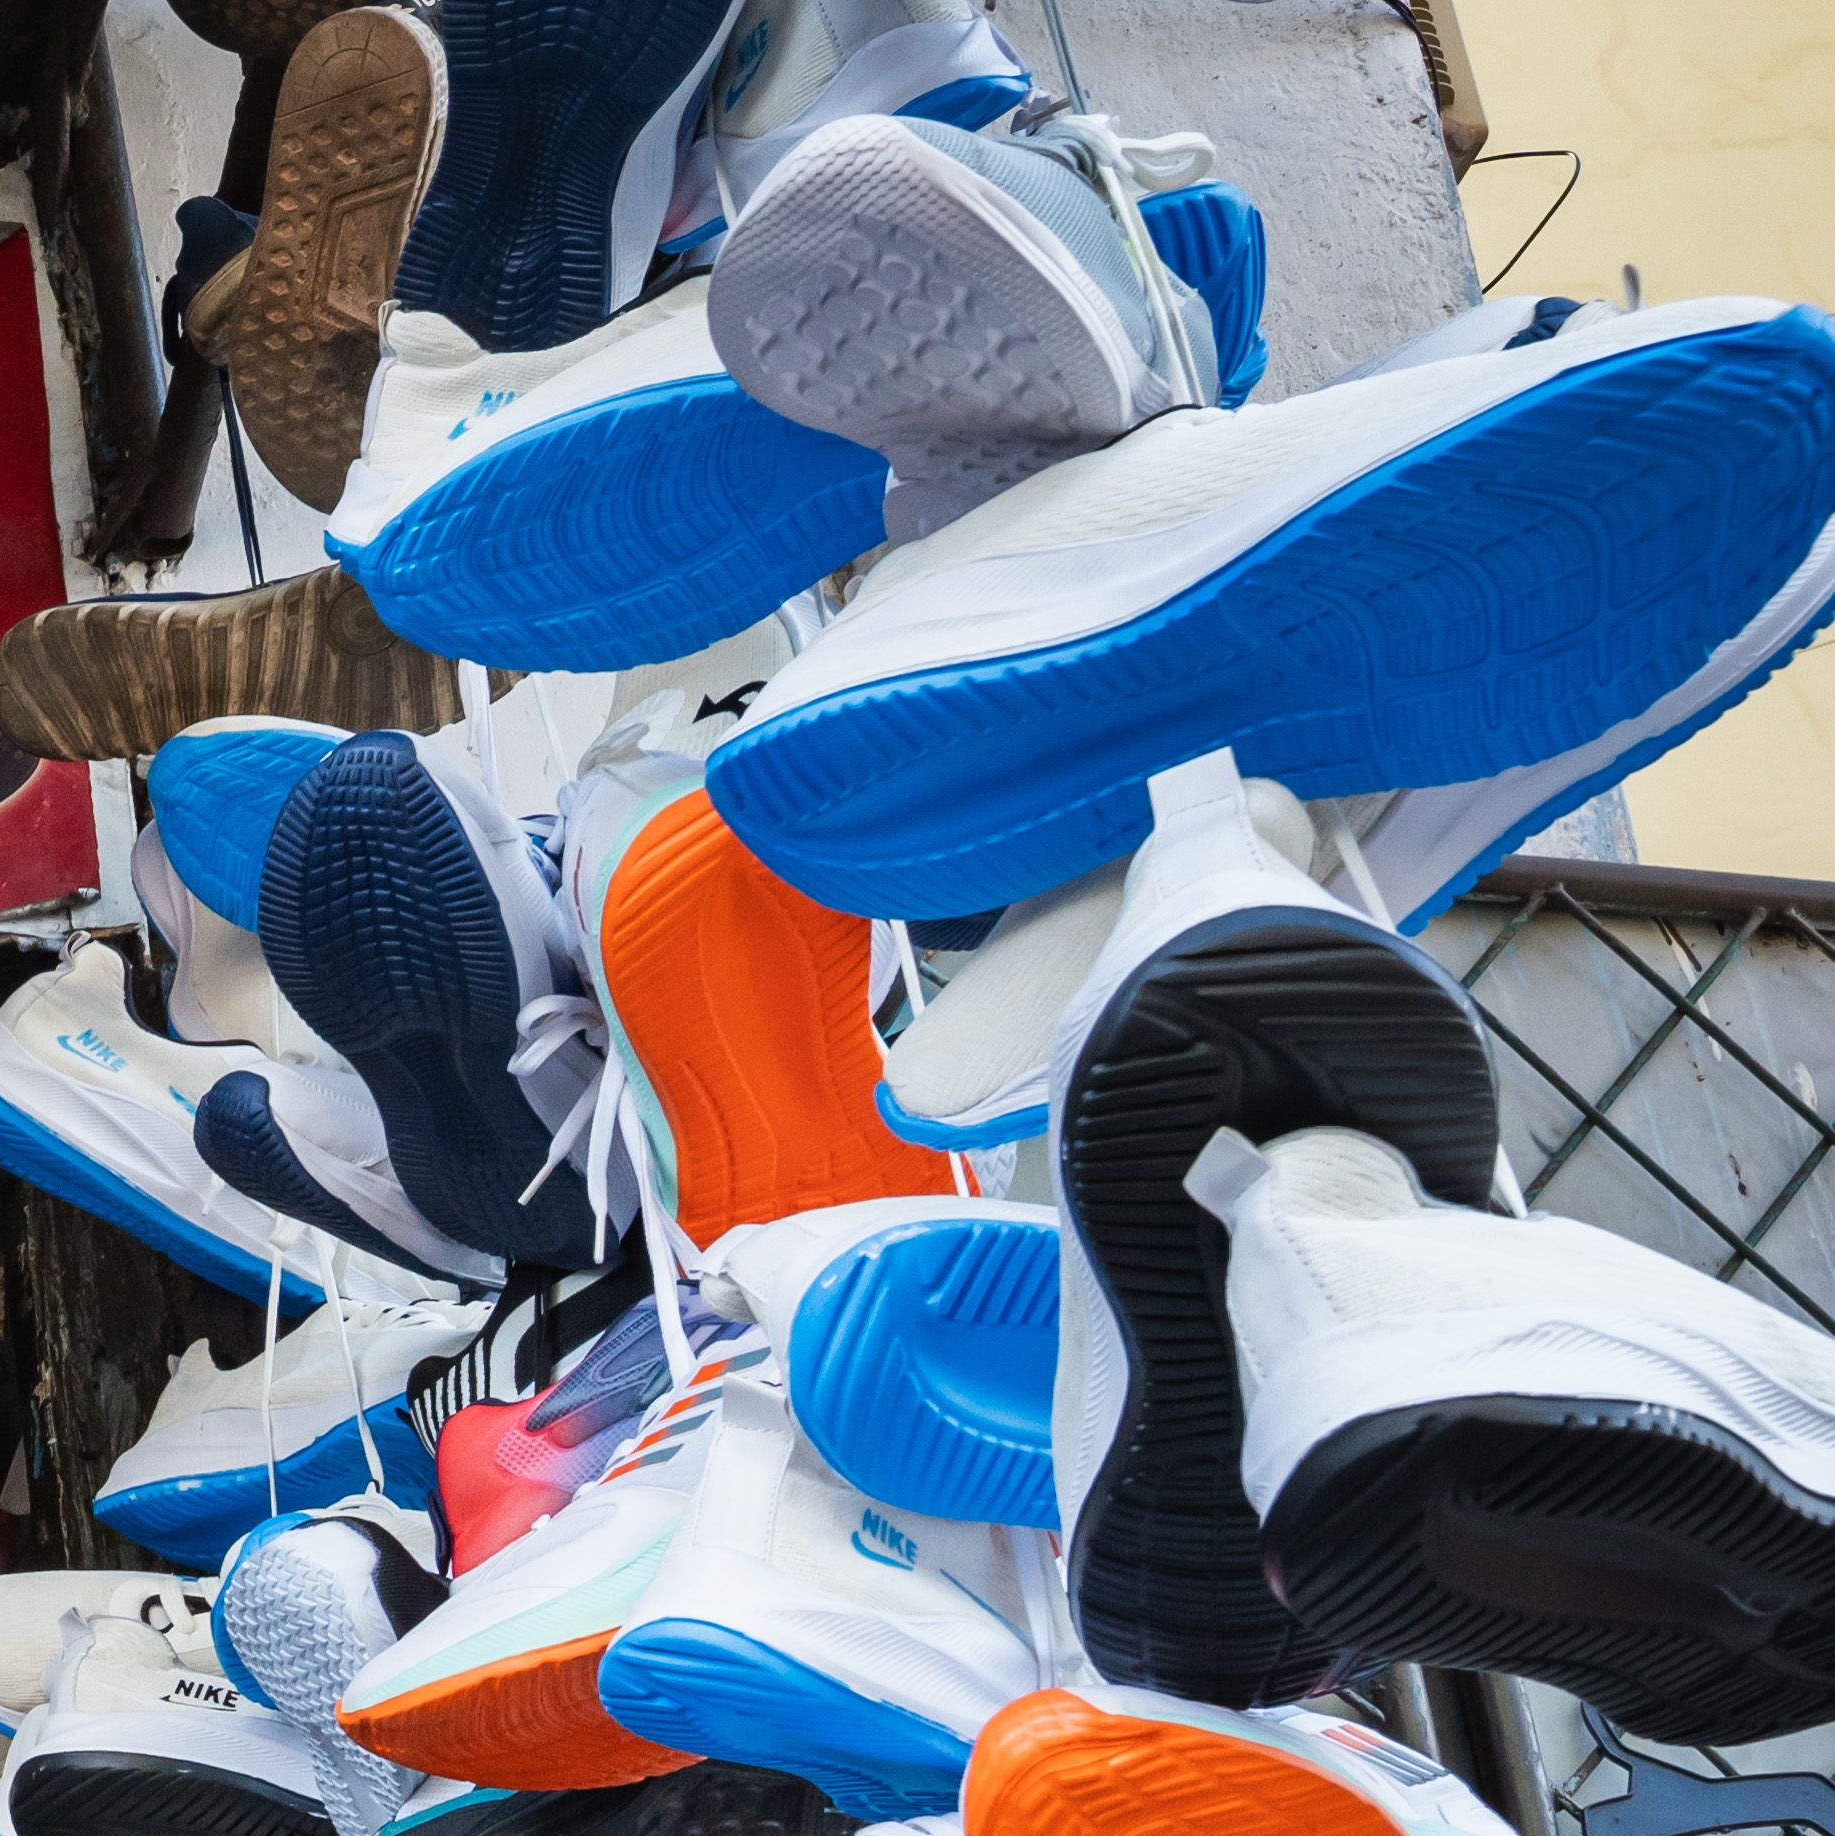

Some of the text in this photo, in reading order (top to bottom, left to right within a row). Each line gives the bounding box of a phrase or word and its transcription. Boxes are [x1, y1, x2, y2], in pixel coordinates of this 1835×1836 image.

[75, 1027, 129, 1073] NIKE
[862, 1507, 918, 1565] NIKE
[174, 1679, 241, 1708] NIKE
